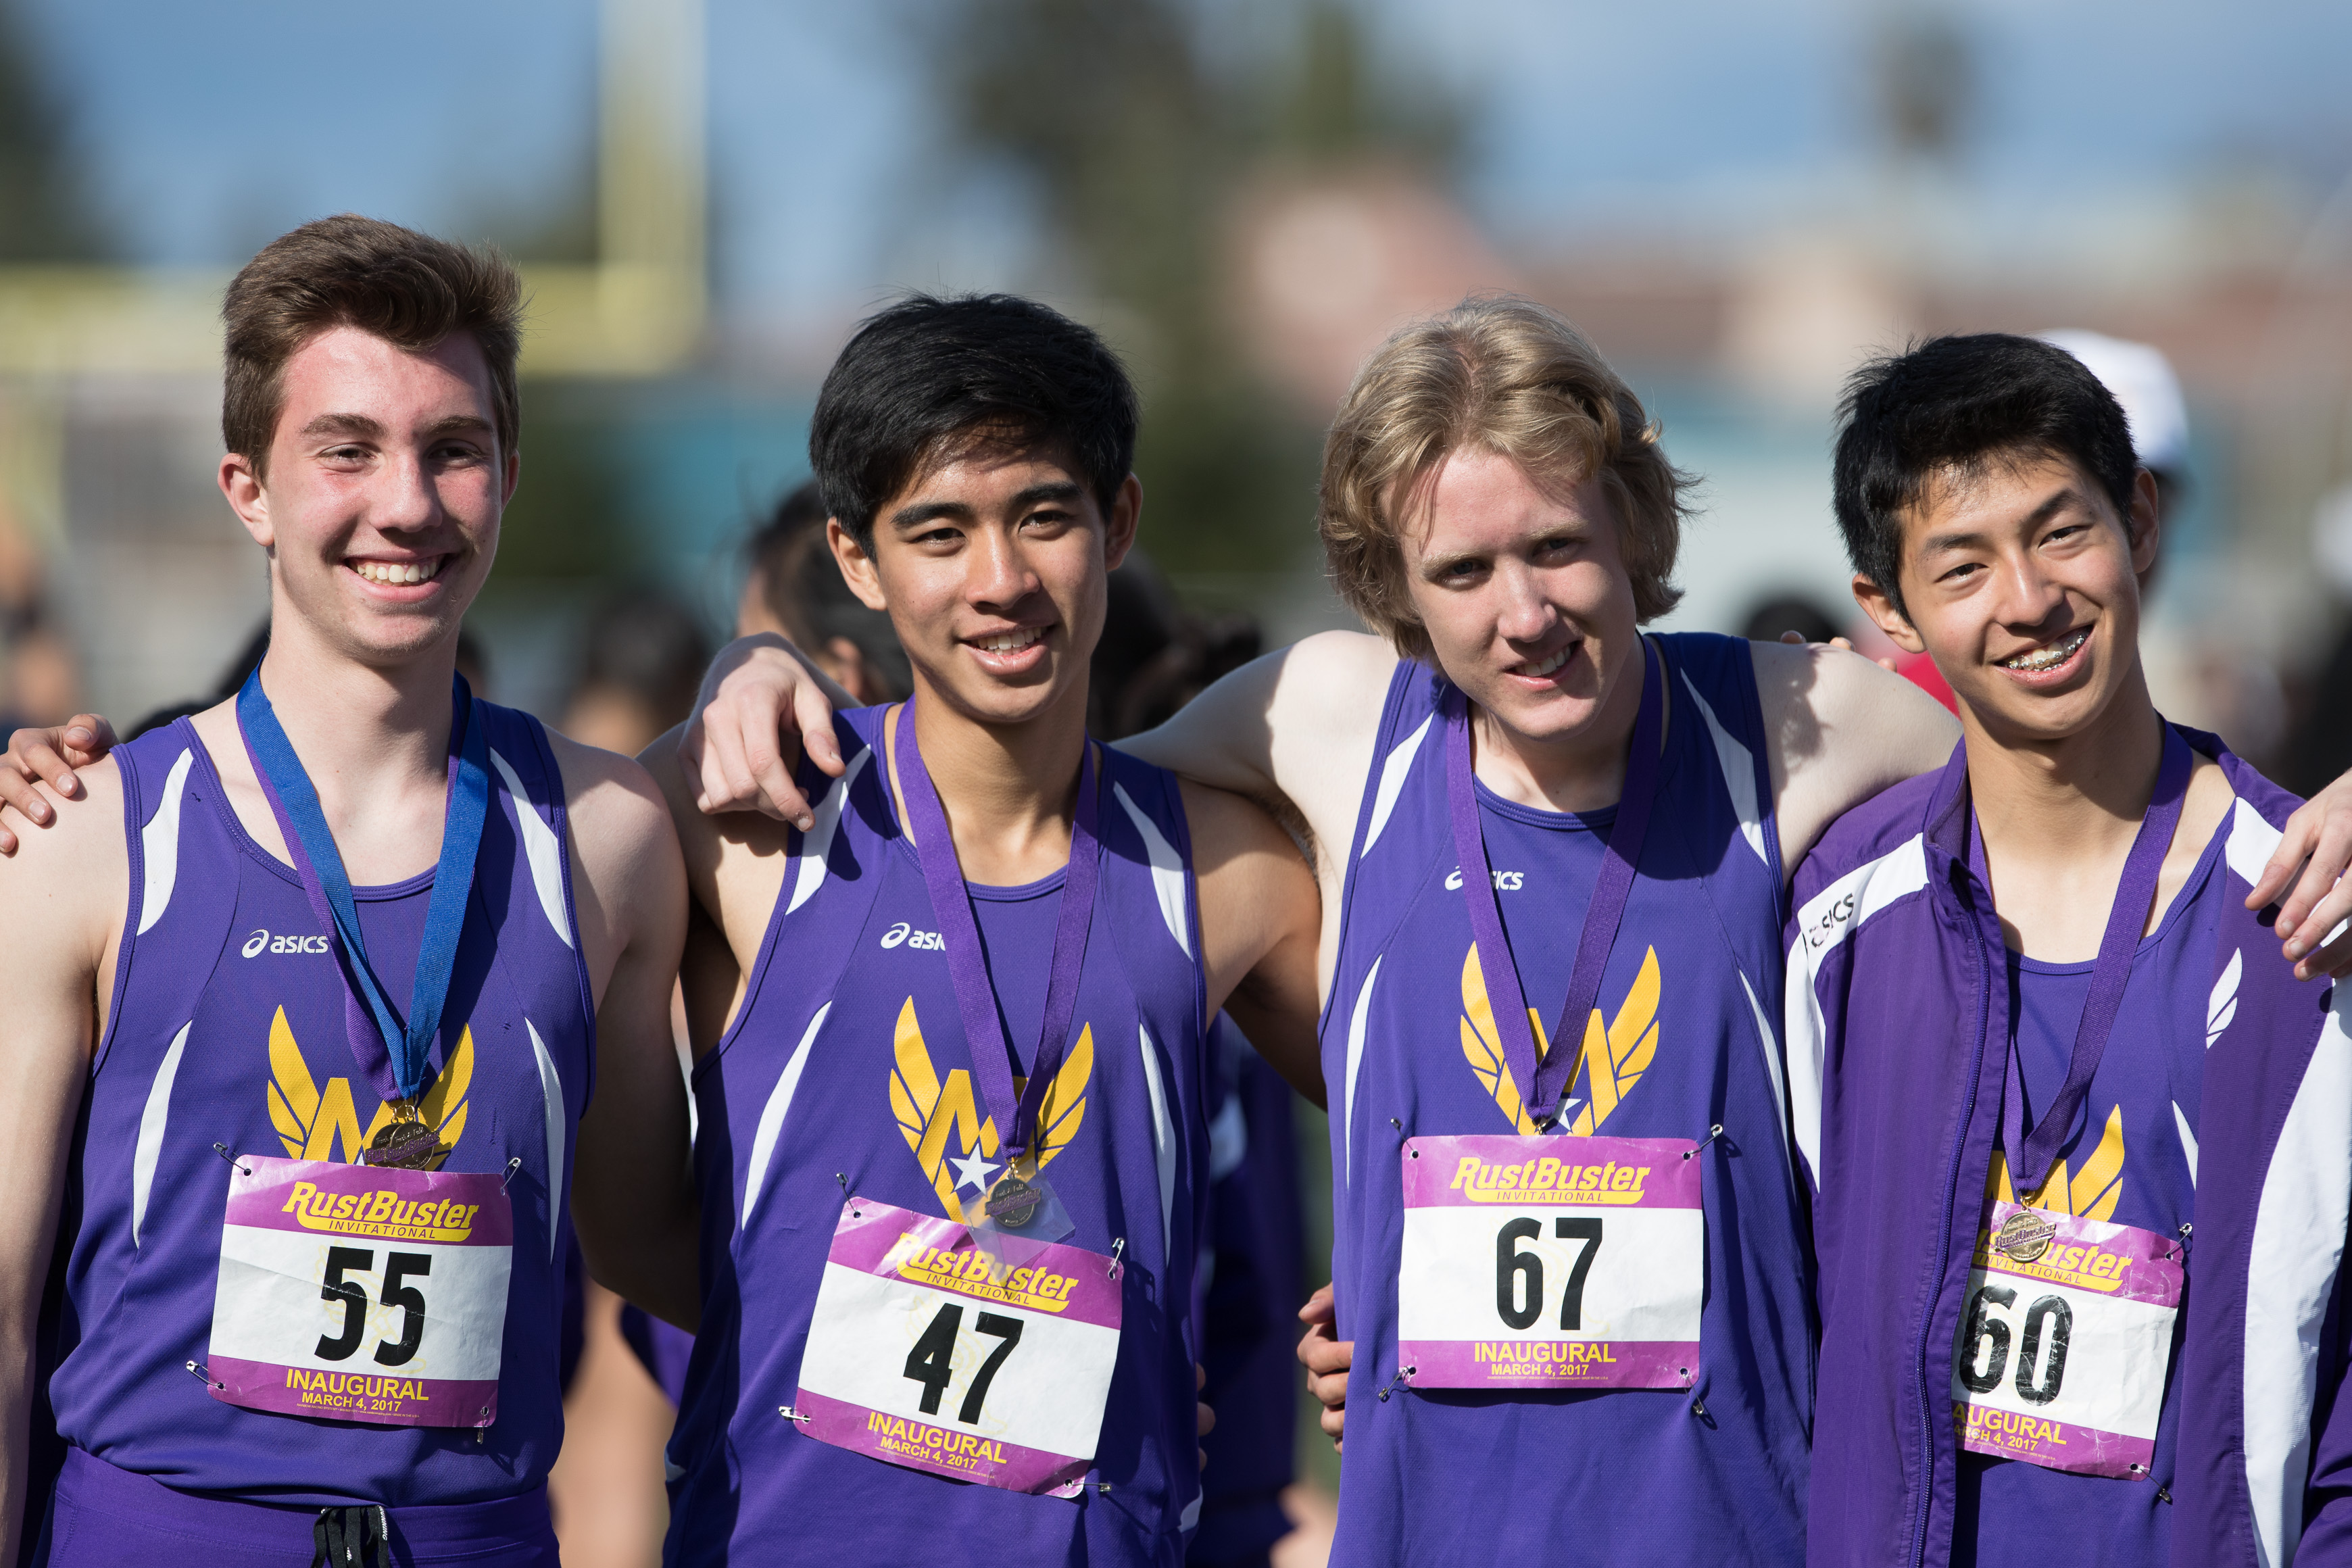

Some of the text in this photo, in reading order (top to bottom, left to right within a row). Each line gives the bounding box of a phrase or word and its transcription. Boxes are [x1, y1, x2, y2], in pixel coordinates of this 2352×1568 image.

[1490, 871, 1524, 890] sics
[270, 935, 328, 954] asics
[908, 930, 946, 951] asi
[1450, 1156, 1651, 1192] RustBuster
[281, 1181, 479, 1229] RustBuster
[1496, 1192, 1604, 1202] INVITATIONAL
[328, 1220, 435, 1239] INVITATIONAL
[883, 1232, 1079, 1301] RustBuster
[1974, 1228, 2133, 1280] suster
[1979, 1254, 2081, 1284] INVITATIONAL
[926, 1273, 1030, 1305] INVITATIONAL
[1496, 1217, 1603, 1331] 67
[314, 1246, 433, 1367] 55
[1474, 1342, 1617, 1363] INAUGURAL
[1959, 1285, 2074, 1406] 60
[903, 1302, 1025, 1425] 47
[1491, 1364, 1589, 1377] MARCH 4, 2017
[286, 1369, 430, 1401] INAUGURAL
[301, 1392, 402, 1412] MARCH 4, 2017
[867, 1411, 1007, 1465] INAUGURAL
[1953, 1403, 2067, 1445] AUGURAL
[1954, 1424, 1990, 1441] ARCH
[1993, 1433, 2004, 1446] 4,
[2007, 1436, 2038, 1451] 2017
[880, 1437, 931, 1459] MARCH
[932, 1450, 944, 1464] 4,
[947, 1454, 979, 1470] 2017
